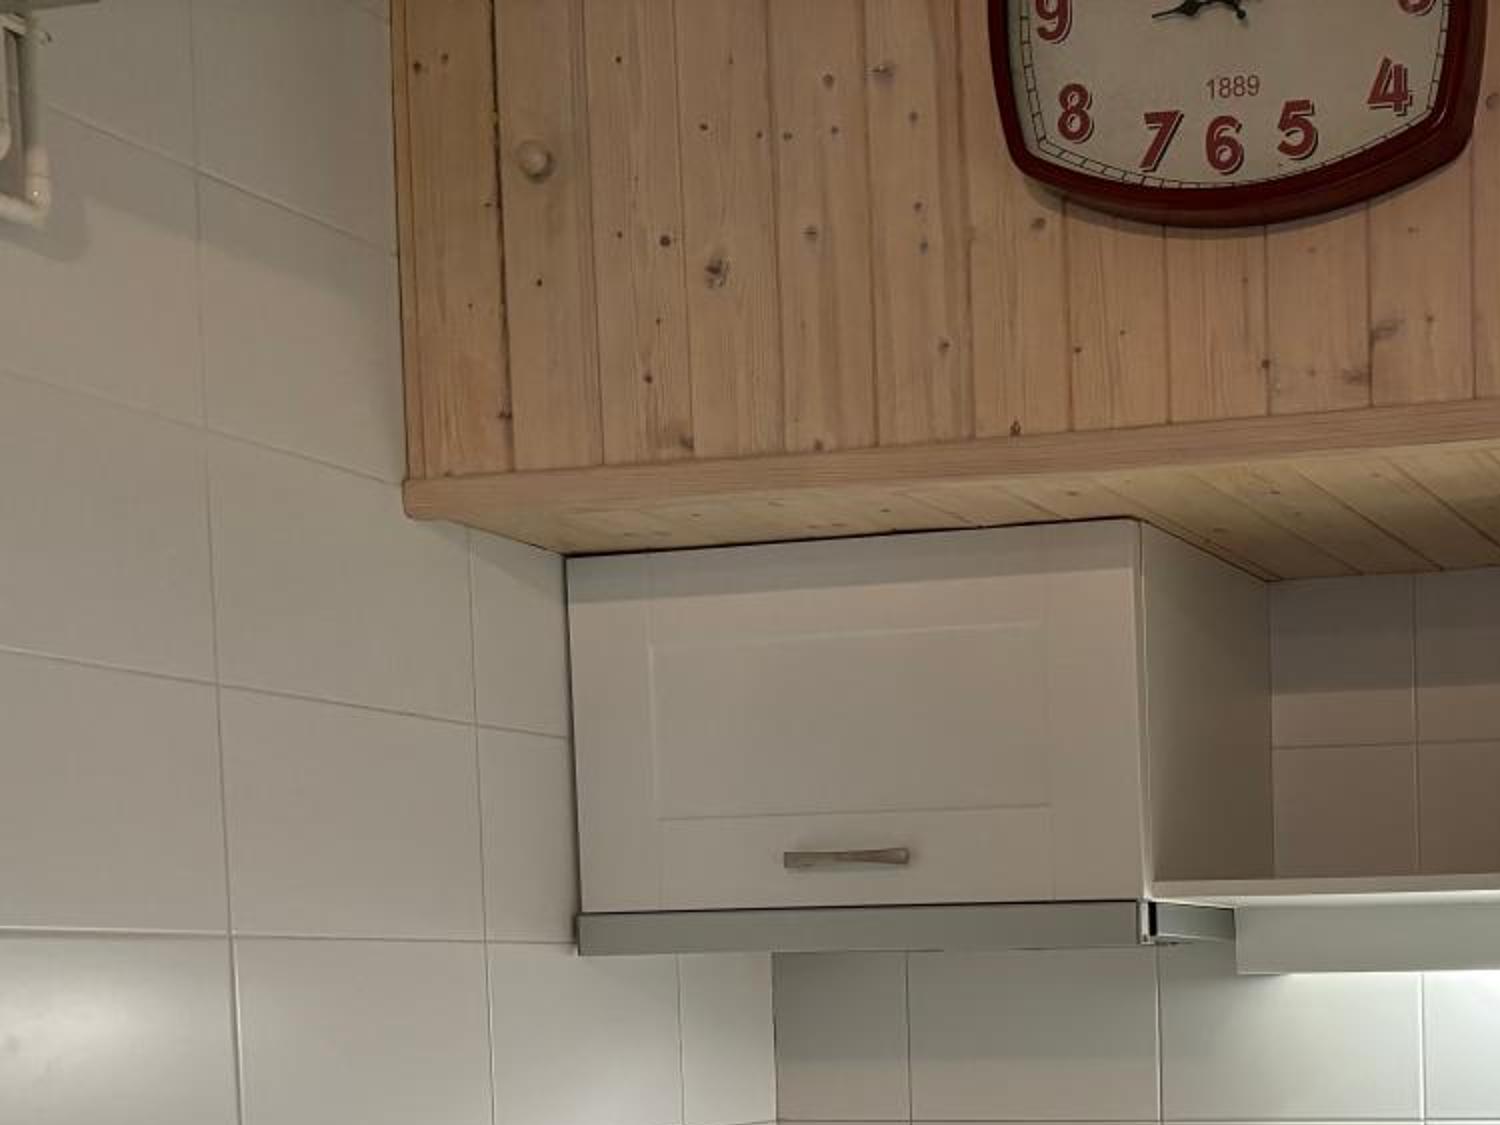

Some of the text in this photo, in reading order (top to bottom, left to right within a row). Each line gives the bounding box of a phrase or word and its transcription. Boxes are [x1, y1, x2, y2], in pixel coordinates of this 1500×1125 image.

[1036, 0, 1072, 44] 9
[1058, 83, 1092, 143] 8
[1206, 76, 1260, 97] 1889
[1367, 57, 1412, 116] 4
[1140, 111, 1184, 171] 7
[1205, 115, 1244, 173] 6
[1277, 100, 1318, 160] 5
